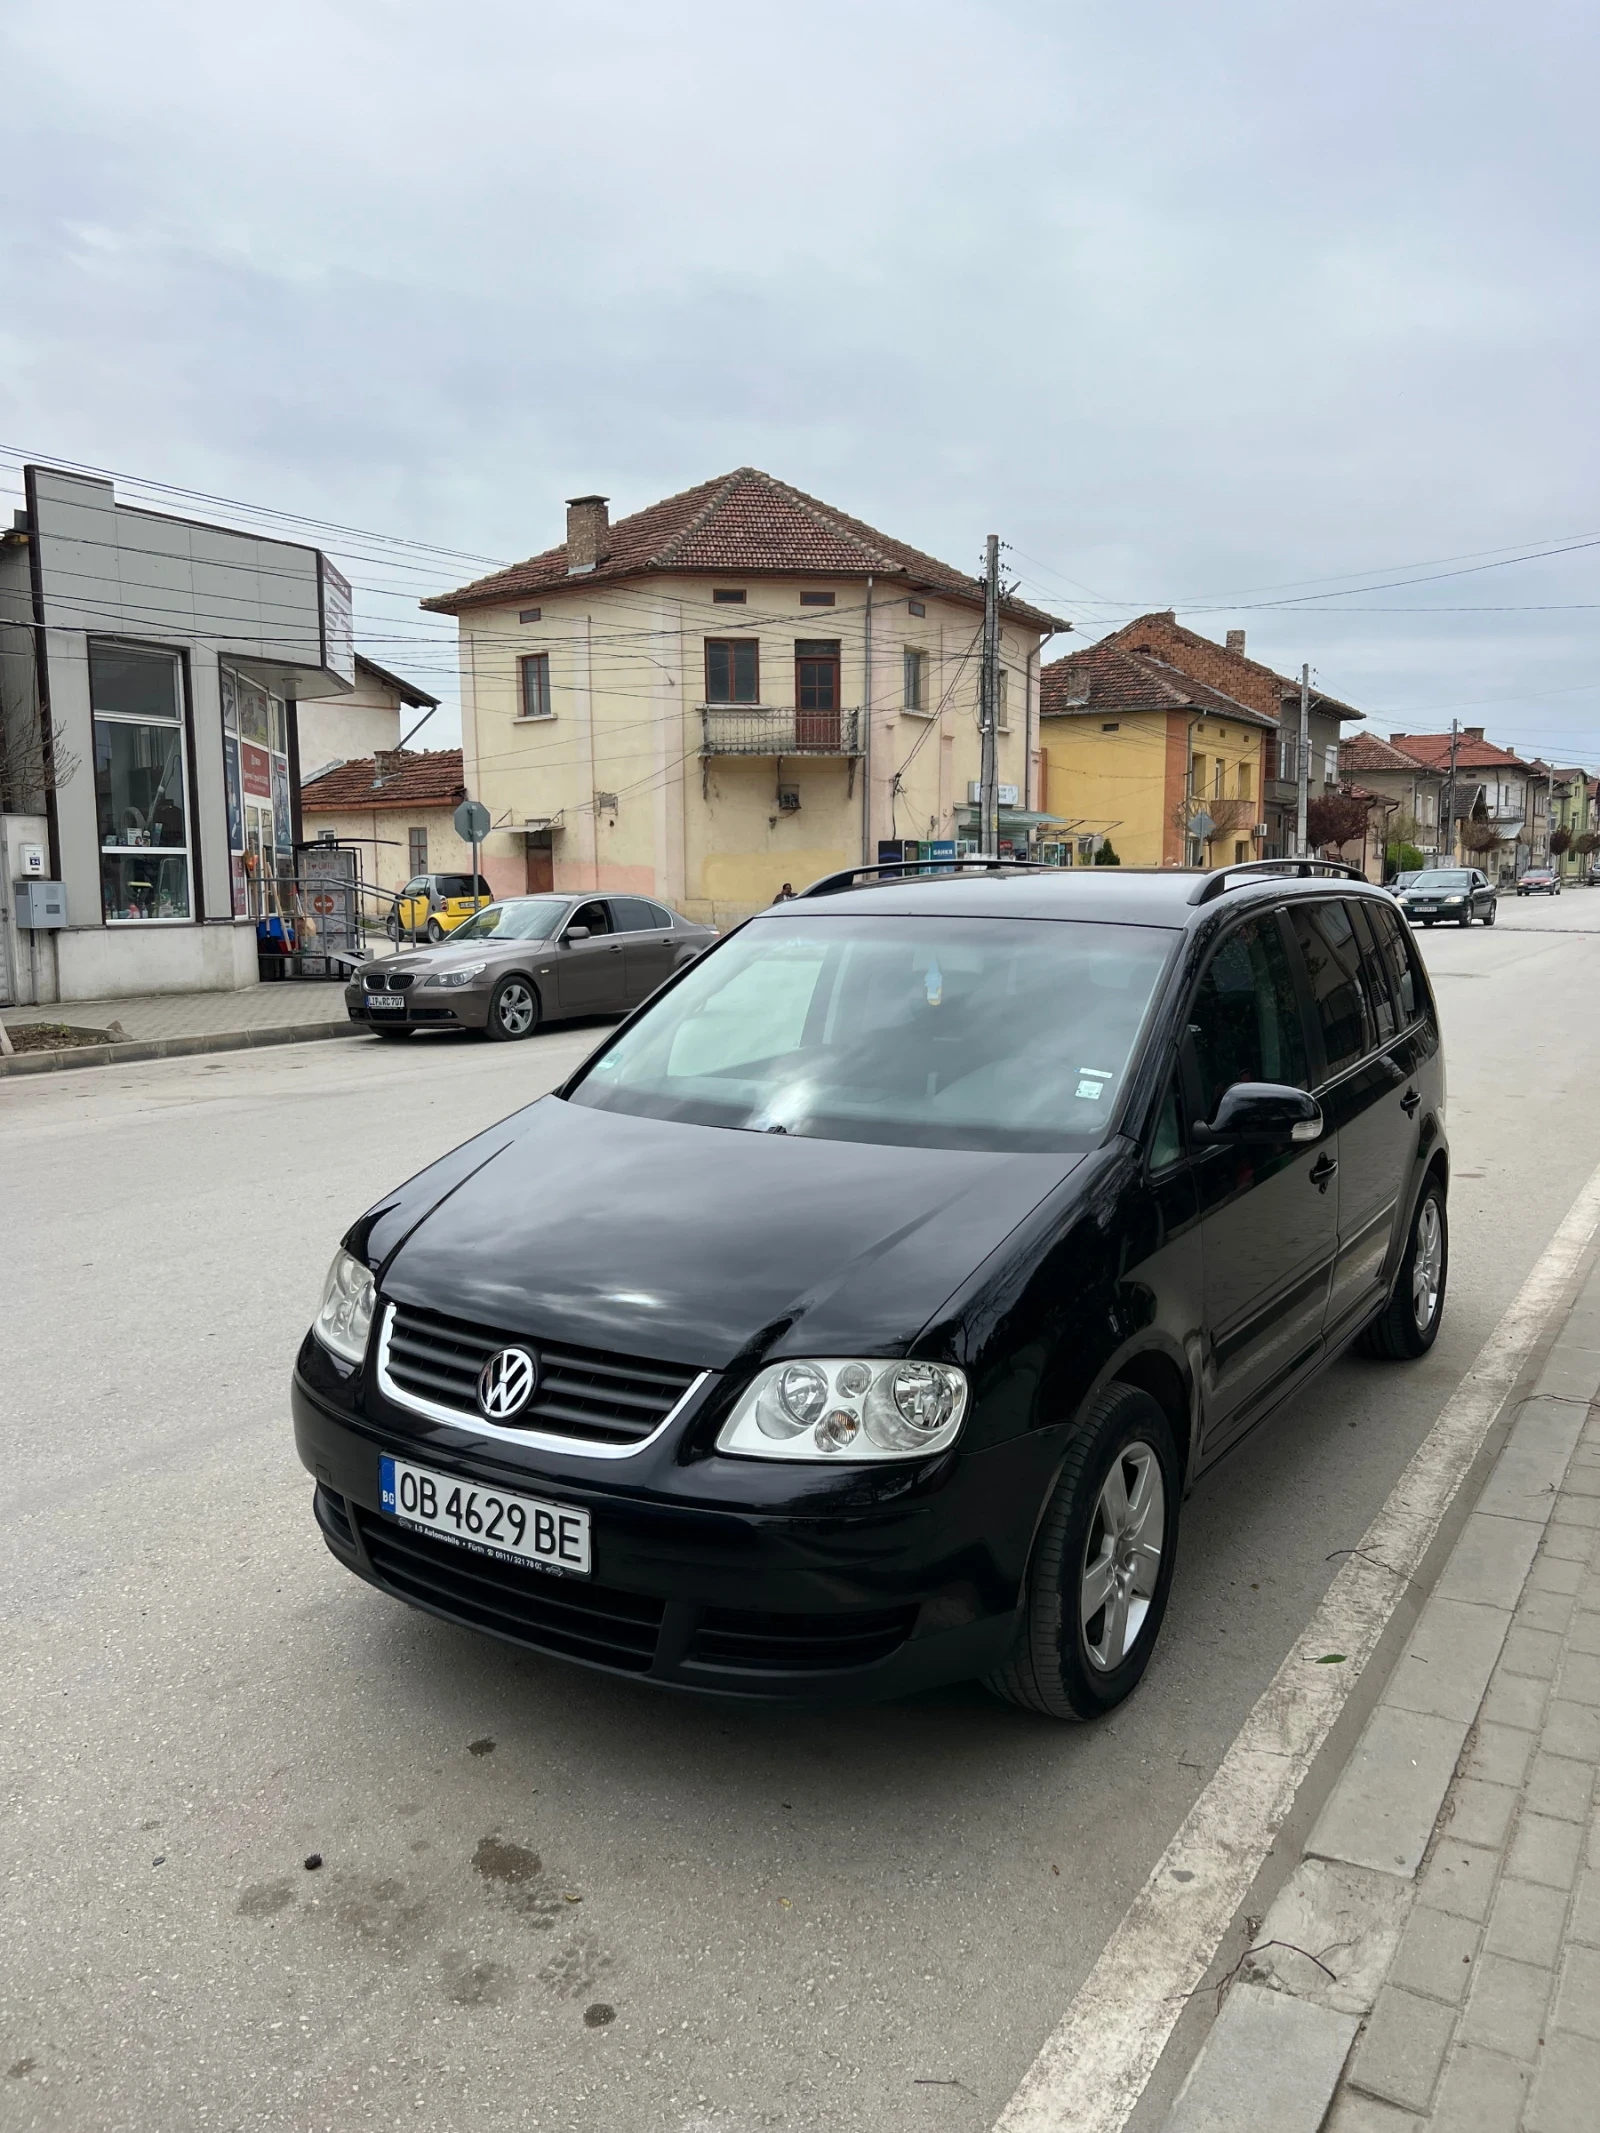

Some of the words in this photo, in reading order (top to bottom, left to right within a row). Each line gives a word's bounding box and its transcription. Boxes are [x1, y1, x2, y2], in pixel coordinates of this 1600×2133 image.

[382, 1490, 395, 1504] BG
[400, 1471, 438, 1519] OB
[445, 1486, 526, 1546] 4629
[534, 1509, 581, 1563] BE
[424, 1527, 460, 1545] Automobile
[467, 1542, 485, 1553] Fürth
